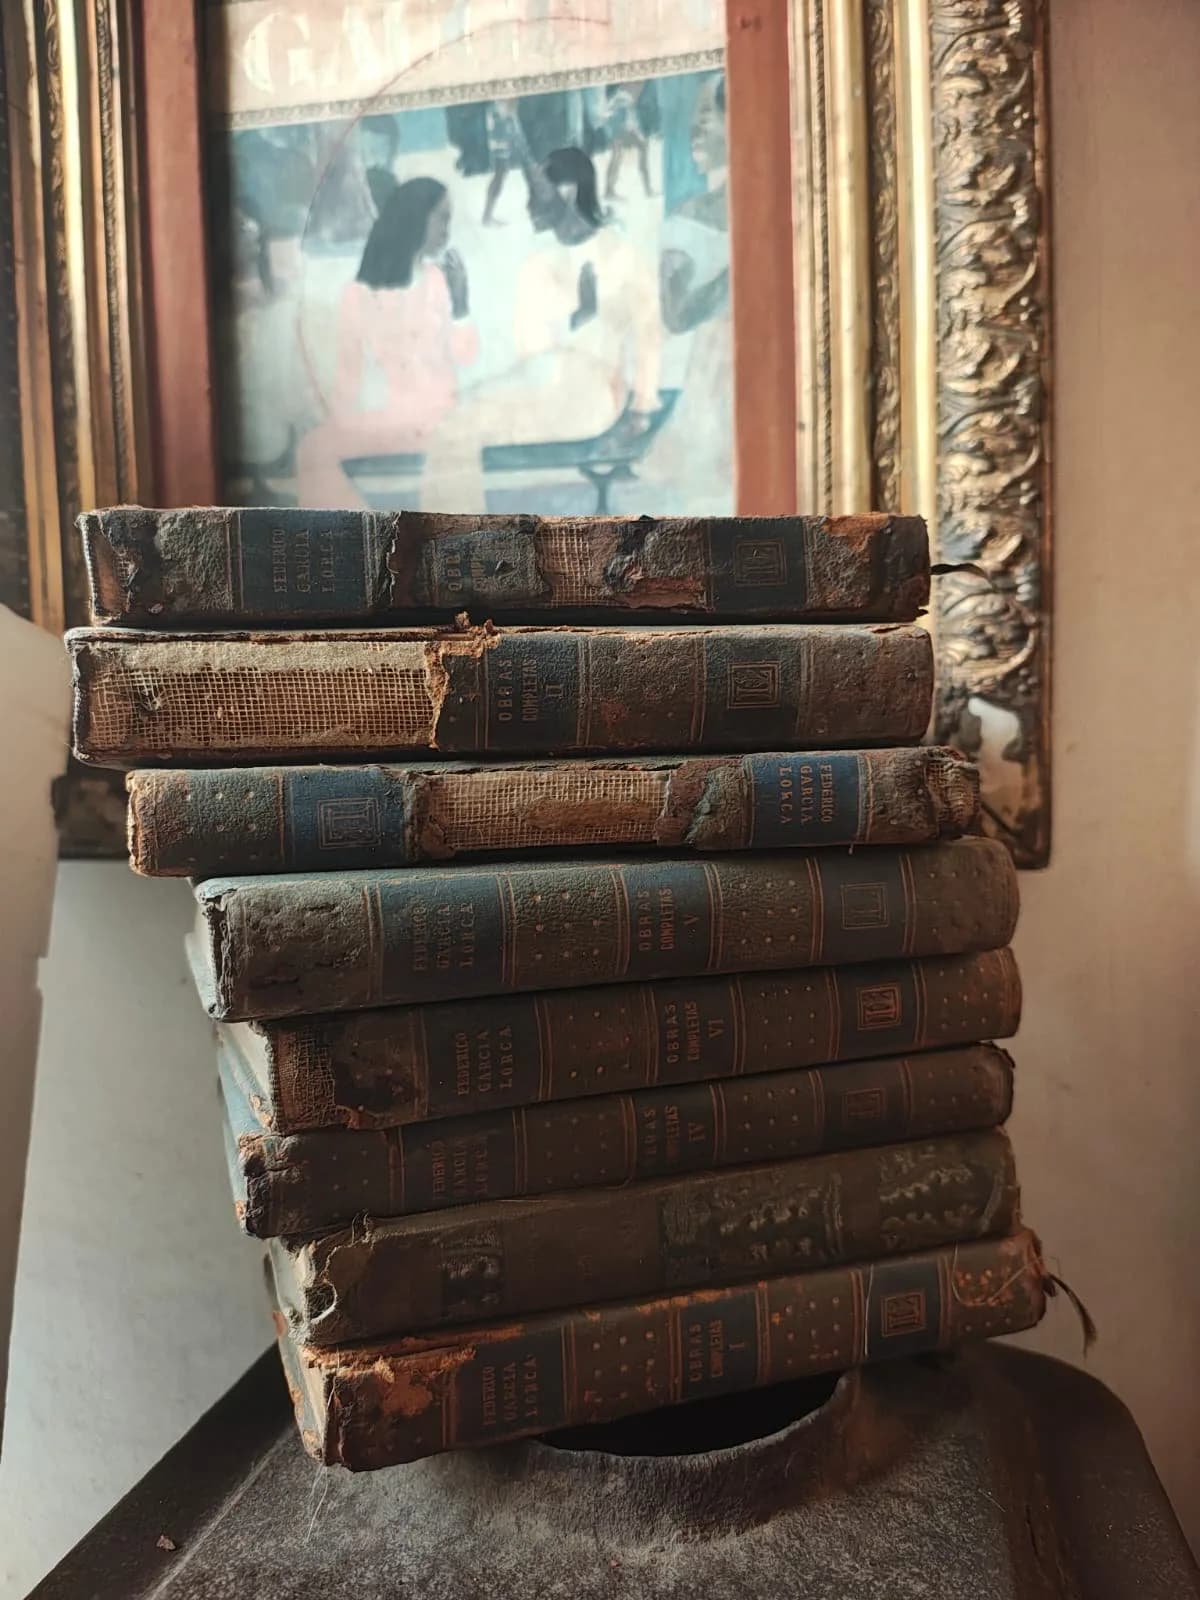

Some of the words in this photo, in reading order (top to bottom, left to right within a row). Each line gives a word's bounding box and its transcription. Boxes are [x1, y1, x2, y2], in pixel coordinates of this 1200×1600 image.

[272, 529, 287, 592] FEDERICO
[296, 529, 311, 592] GARCIA
[321, 529, 335, 592] LORCA
[497, 659, 513, 721] OBRAS
[522, 658, 537, 721] COMPLETAS
[779, 766, 793, 824] LORCA
[800, 765, 814, 824] GARCIA
[820, 764, 833, 822] FEDERICO
[637, 890, 652, 950] OBRAS
[659, 888, 673, 950] COMPLETAS
[683, 913, 699, 926] V
[498, 1026, 513, 1089] LORCA
[665, 1001, 679, 1064] OBRAS
[708, 1017, 724, 1039] VI
[456, 1032, 470, 1095] FEDERICO
[477, 1031, 492, 1092] GARCIA
